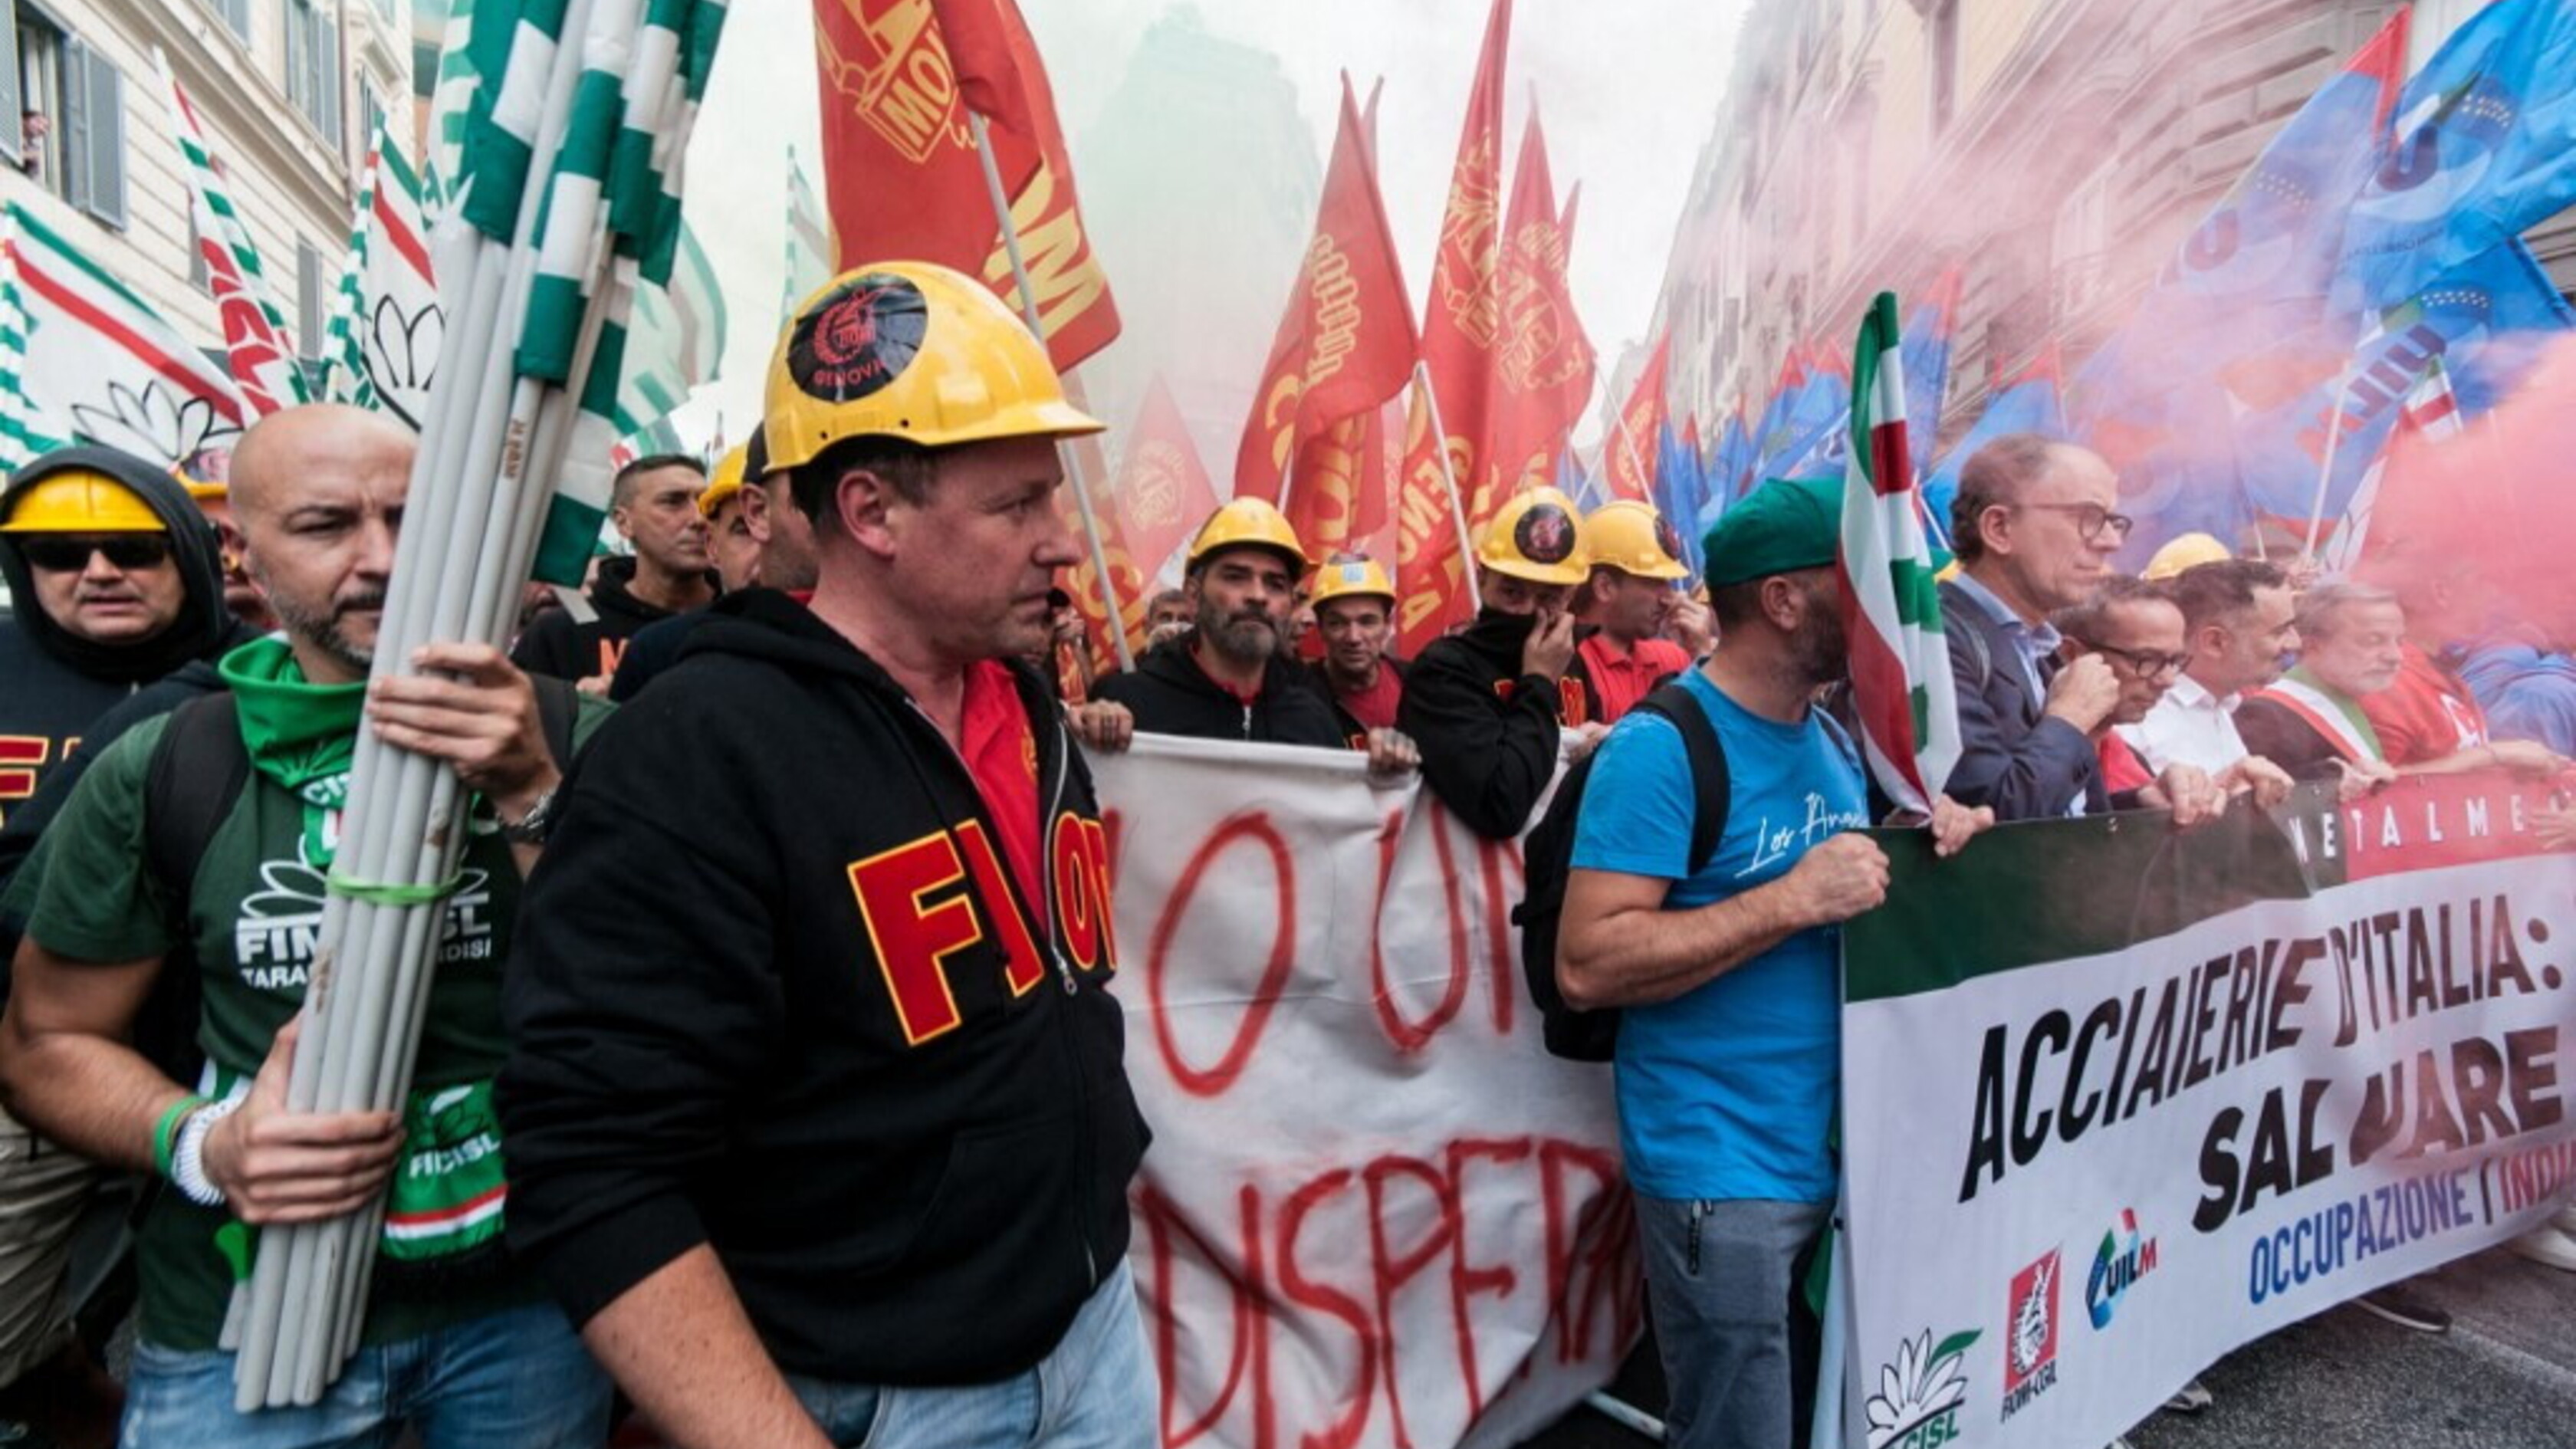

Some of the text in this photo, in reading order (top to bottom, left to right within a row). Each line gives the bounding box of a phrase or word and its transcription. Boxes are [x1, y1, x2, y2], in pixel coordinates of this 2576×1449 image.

[1734, 816, 1795, 879] Los
[1958, 893, 2563, 1204] ACCIAIERIE D'ITALIA:
[2105, 1237, 2157, 1296] UILM
[2248, 1165, 2473, 1304] OCCUPAZIONE
